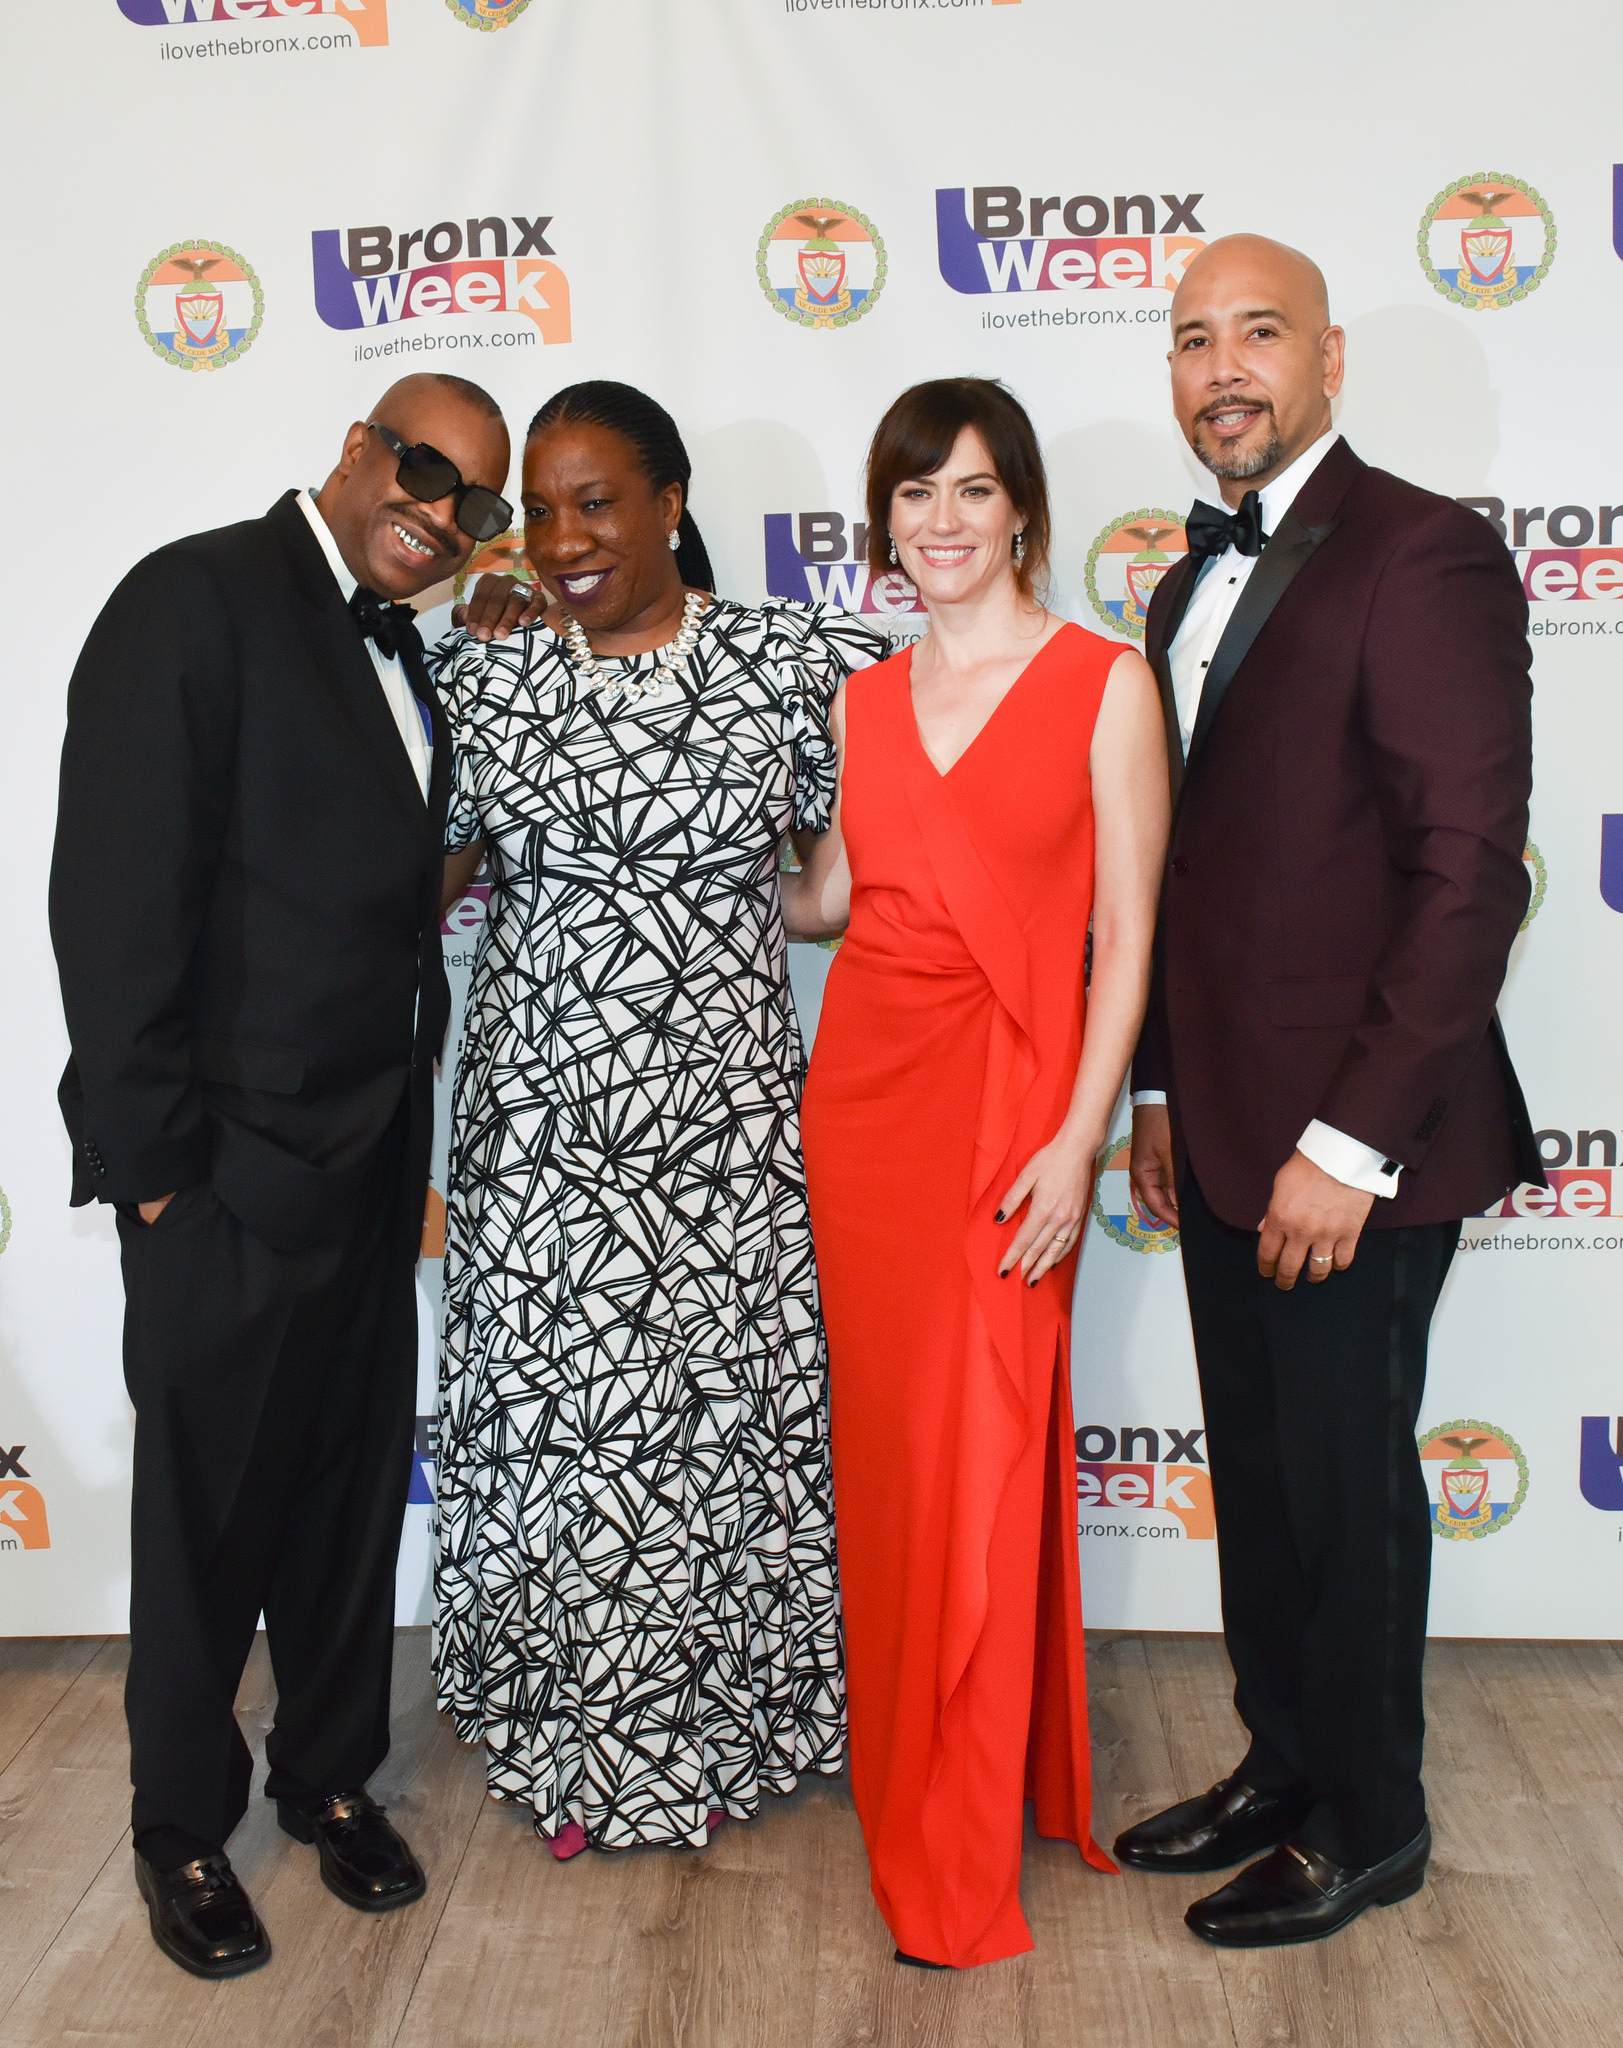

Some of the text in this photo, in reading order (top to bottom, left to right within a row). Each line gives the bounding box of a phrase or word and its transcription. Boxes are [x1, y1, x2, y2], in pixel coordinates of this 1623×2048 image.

[160, 34, 352, 60] ilovethebronx.com
[973, 186, 1207, 238] Bronx
[347, 216, 557, 277] Bronx
[977, 236, 1198, 292] Week
[352, 259, 551, 327] Week
[1471, 286, 1492, 294] CEDE
[1493, 279, 1515, 292] MALIS
[354, 332, 536, 362] ilovethebronx.com
[1456, 1234, 1623, 1250] ovethebronx.co
[1075, 1425, 1206, 1464] onx
[1077, 1464, 1197, 1509] eek
